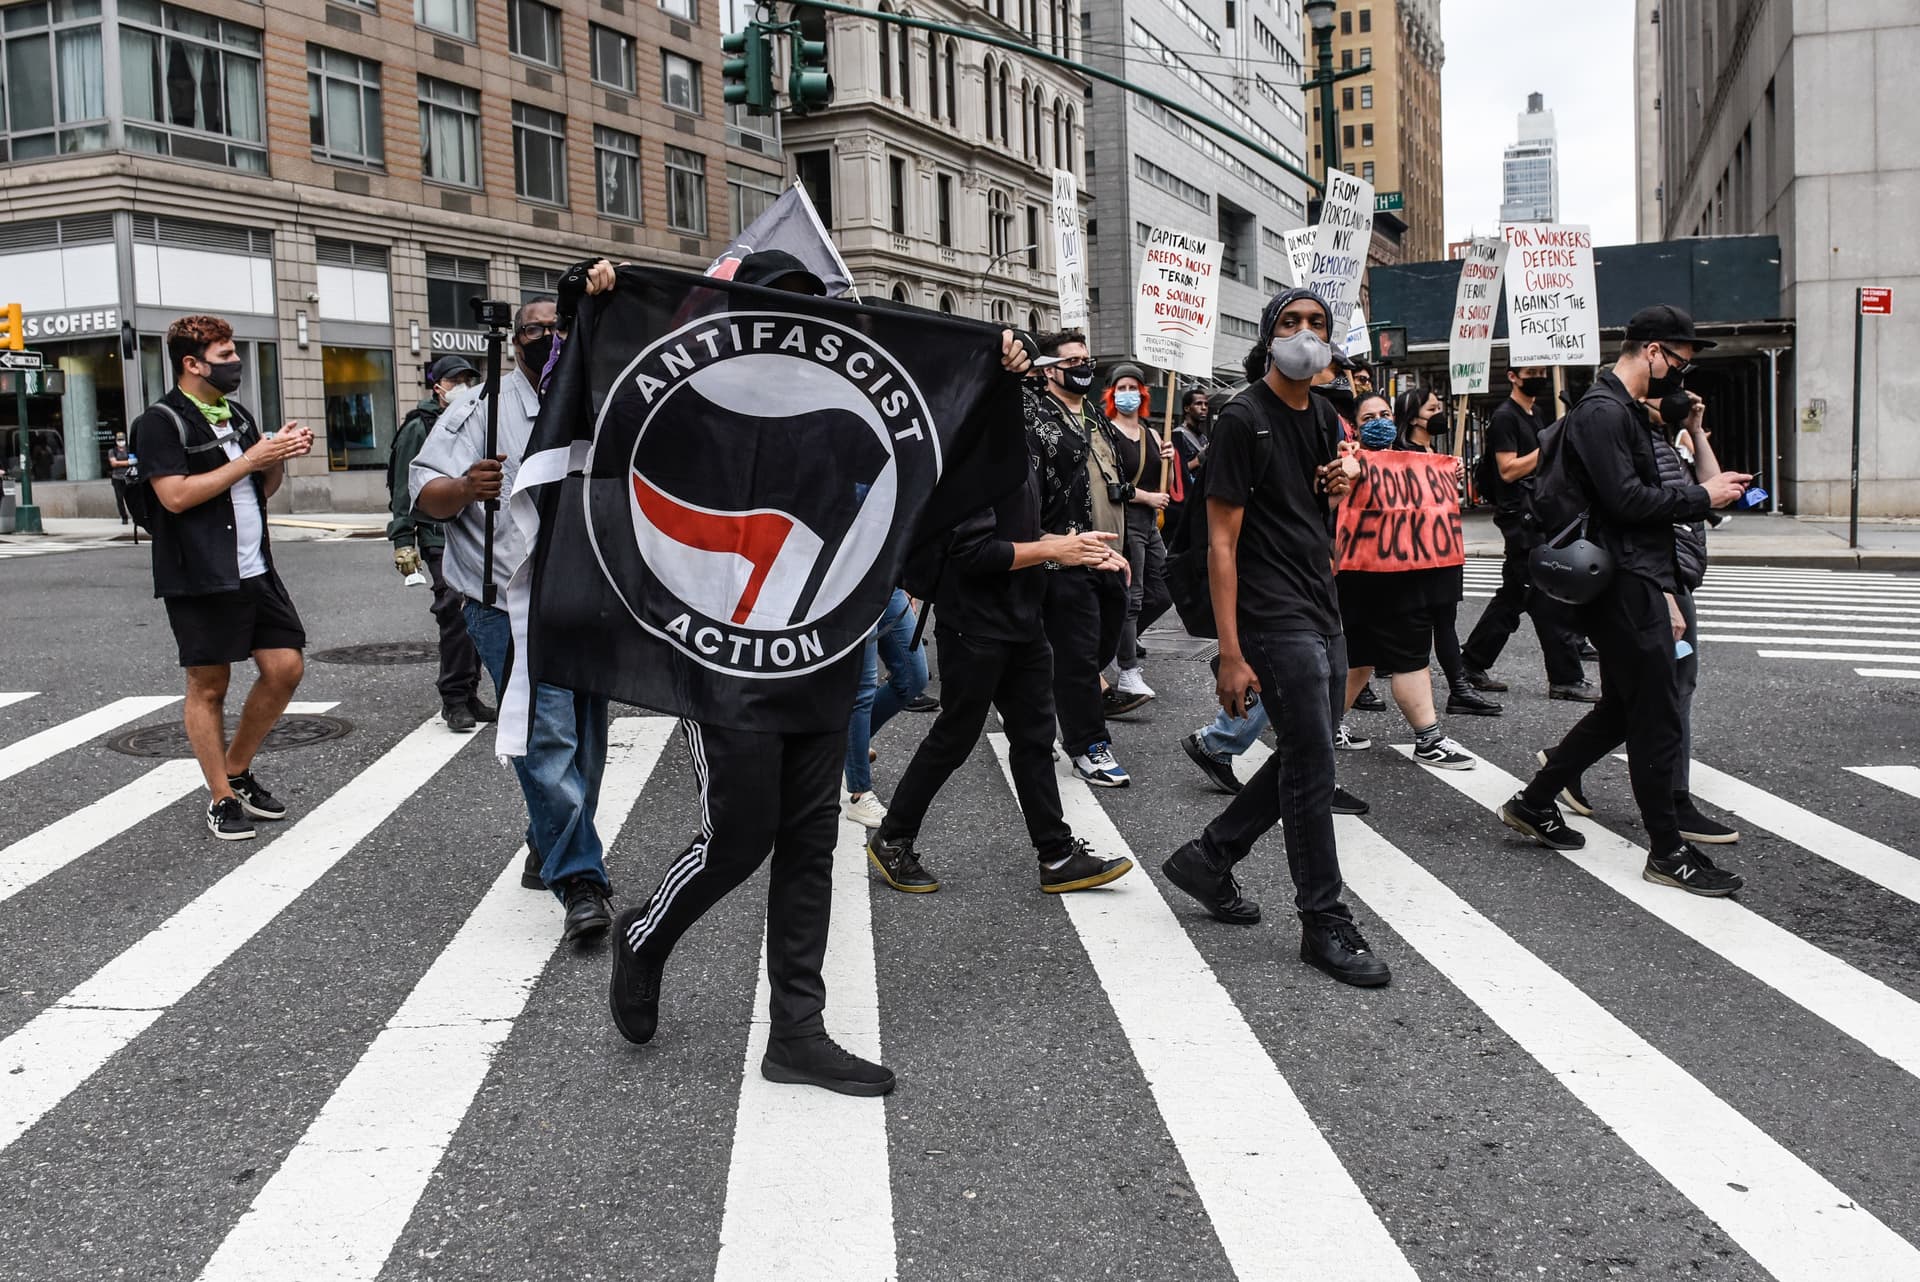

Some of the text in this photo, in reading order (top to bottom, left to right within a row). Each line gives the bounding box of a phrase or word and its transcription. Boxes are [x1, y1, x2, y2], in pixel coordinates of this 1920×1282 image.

[1332, 177, 1360, 205] FROM
[1389, 194, 1399, 203] ST
[1323, 201, 1364, 231] PORTLAND
[1062, 231, 1077, 259] OUT
[1151, 227, 1207, 256] CAPITALISM
[1332, 230, 1354, 251] NYC
[1505, 226, 1591, 249] FOR WORKERS
[1147, 249, 1213, 277] BREEDS RACIST
[1311, 252, 1360, 279] DEMOCRATS
[1522, 249, 1577, 268] DEFENSE
[1158, 268, 1199, 290] TERROR!
[1309, 280, 1346, 299] PROTECT
[1525, 270, 1574, 292] GUARDS
[1142, 283, 1207, 309] FOR SOCIALIST
[1514, 292, 1586, 314] AGAINST THE
[42, 310, 117, 335] COFFEE
[1520, 316, 1569, 335] FASCIST
[432, 331, 490, 352] SOUND
[1546, 333, 1586, 349] THREAT
[4, 356, 17, 364] ONE
[633, 321, 925, 443] ANTIFASCIST
[1348, 455, 1423, 510] PROUD
[1348, 510, 1432, 562] FUCK
[665, 612, 826, 667] ACTION
